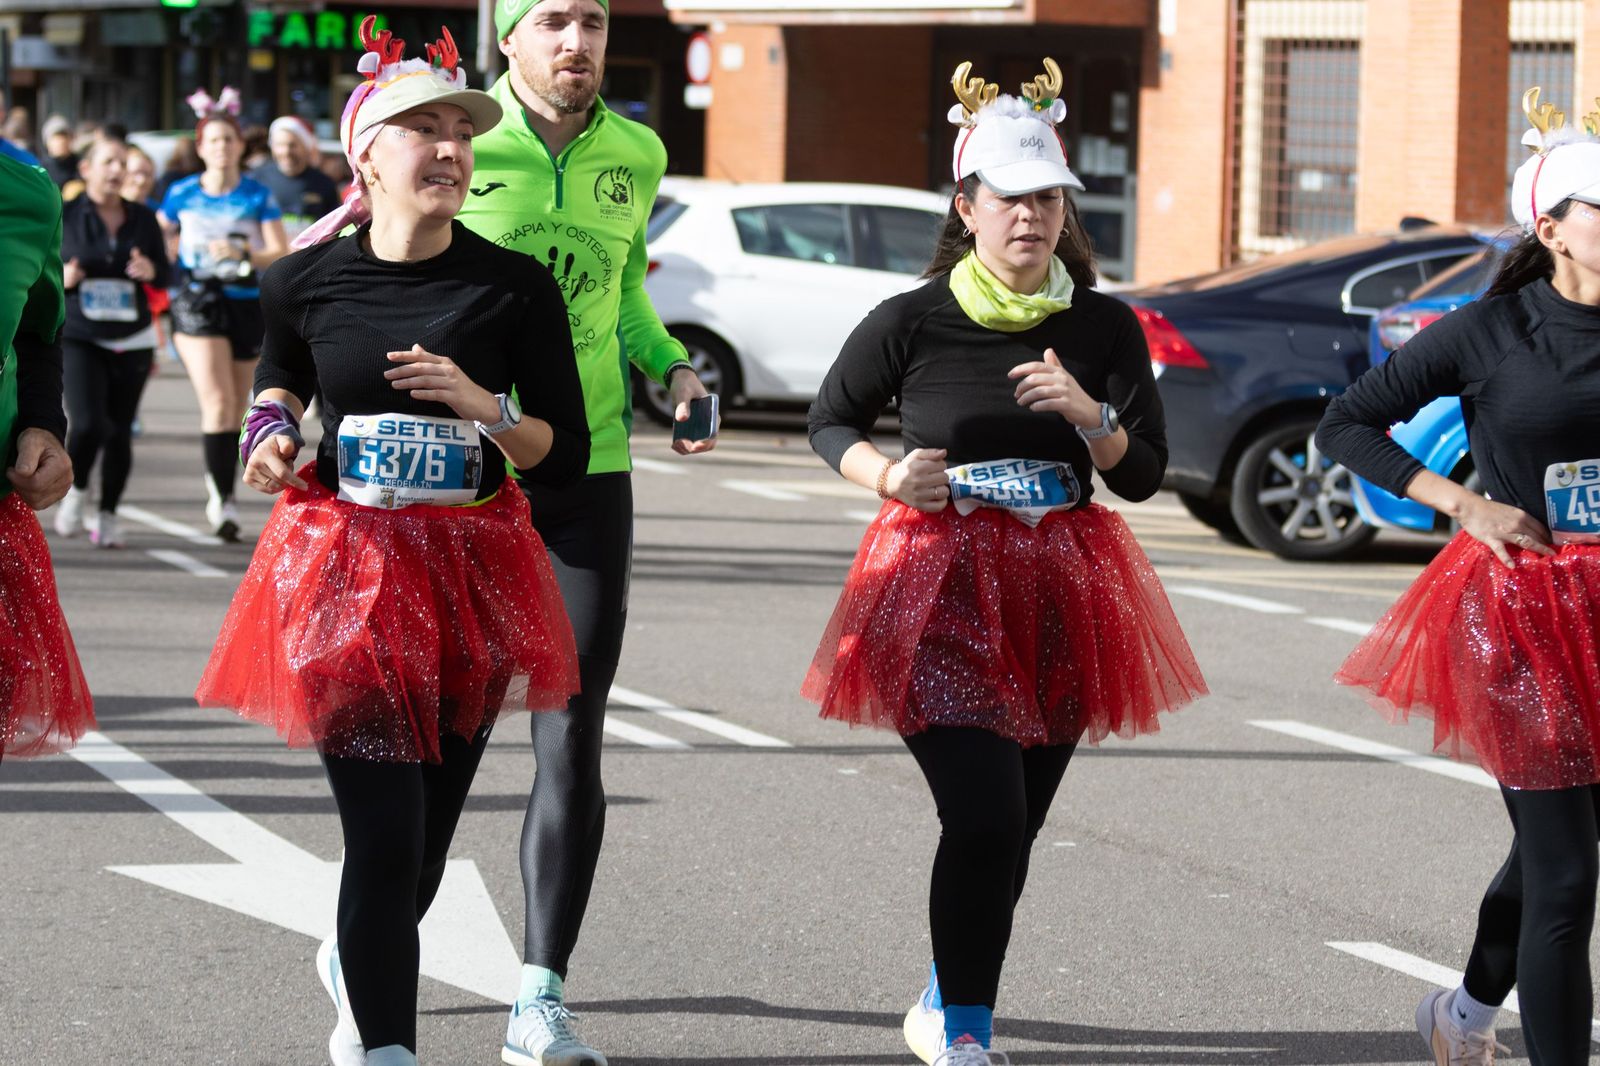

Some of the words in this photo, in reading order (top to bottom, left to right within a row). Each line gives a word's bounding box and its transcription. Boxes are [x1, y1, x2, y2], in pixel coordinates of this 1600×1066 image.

[1020, 135, 1045, 151] edp
[493, 222, 546, 249] ERAPIA
[551, 222, 562, 233] Y
[377, 420, 466, 441] SETEL
[358, 438, 447, 482] 5376
[1581, 465, 1600, 480] S
[1567, 484, 1600, 526] 49
